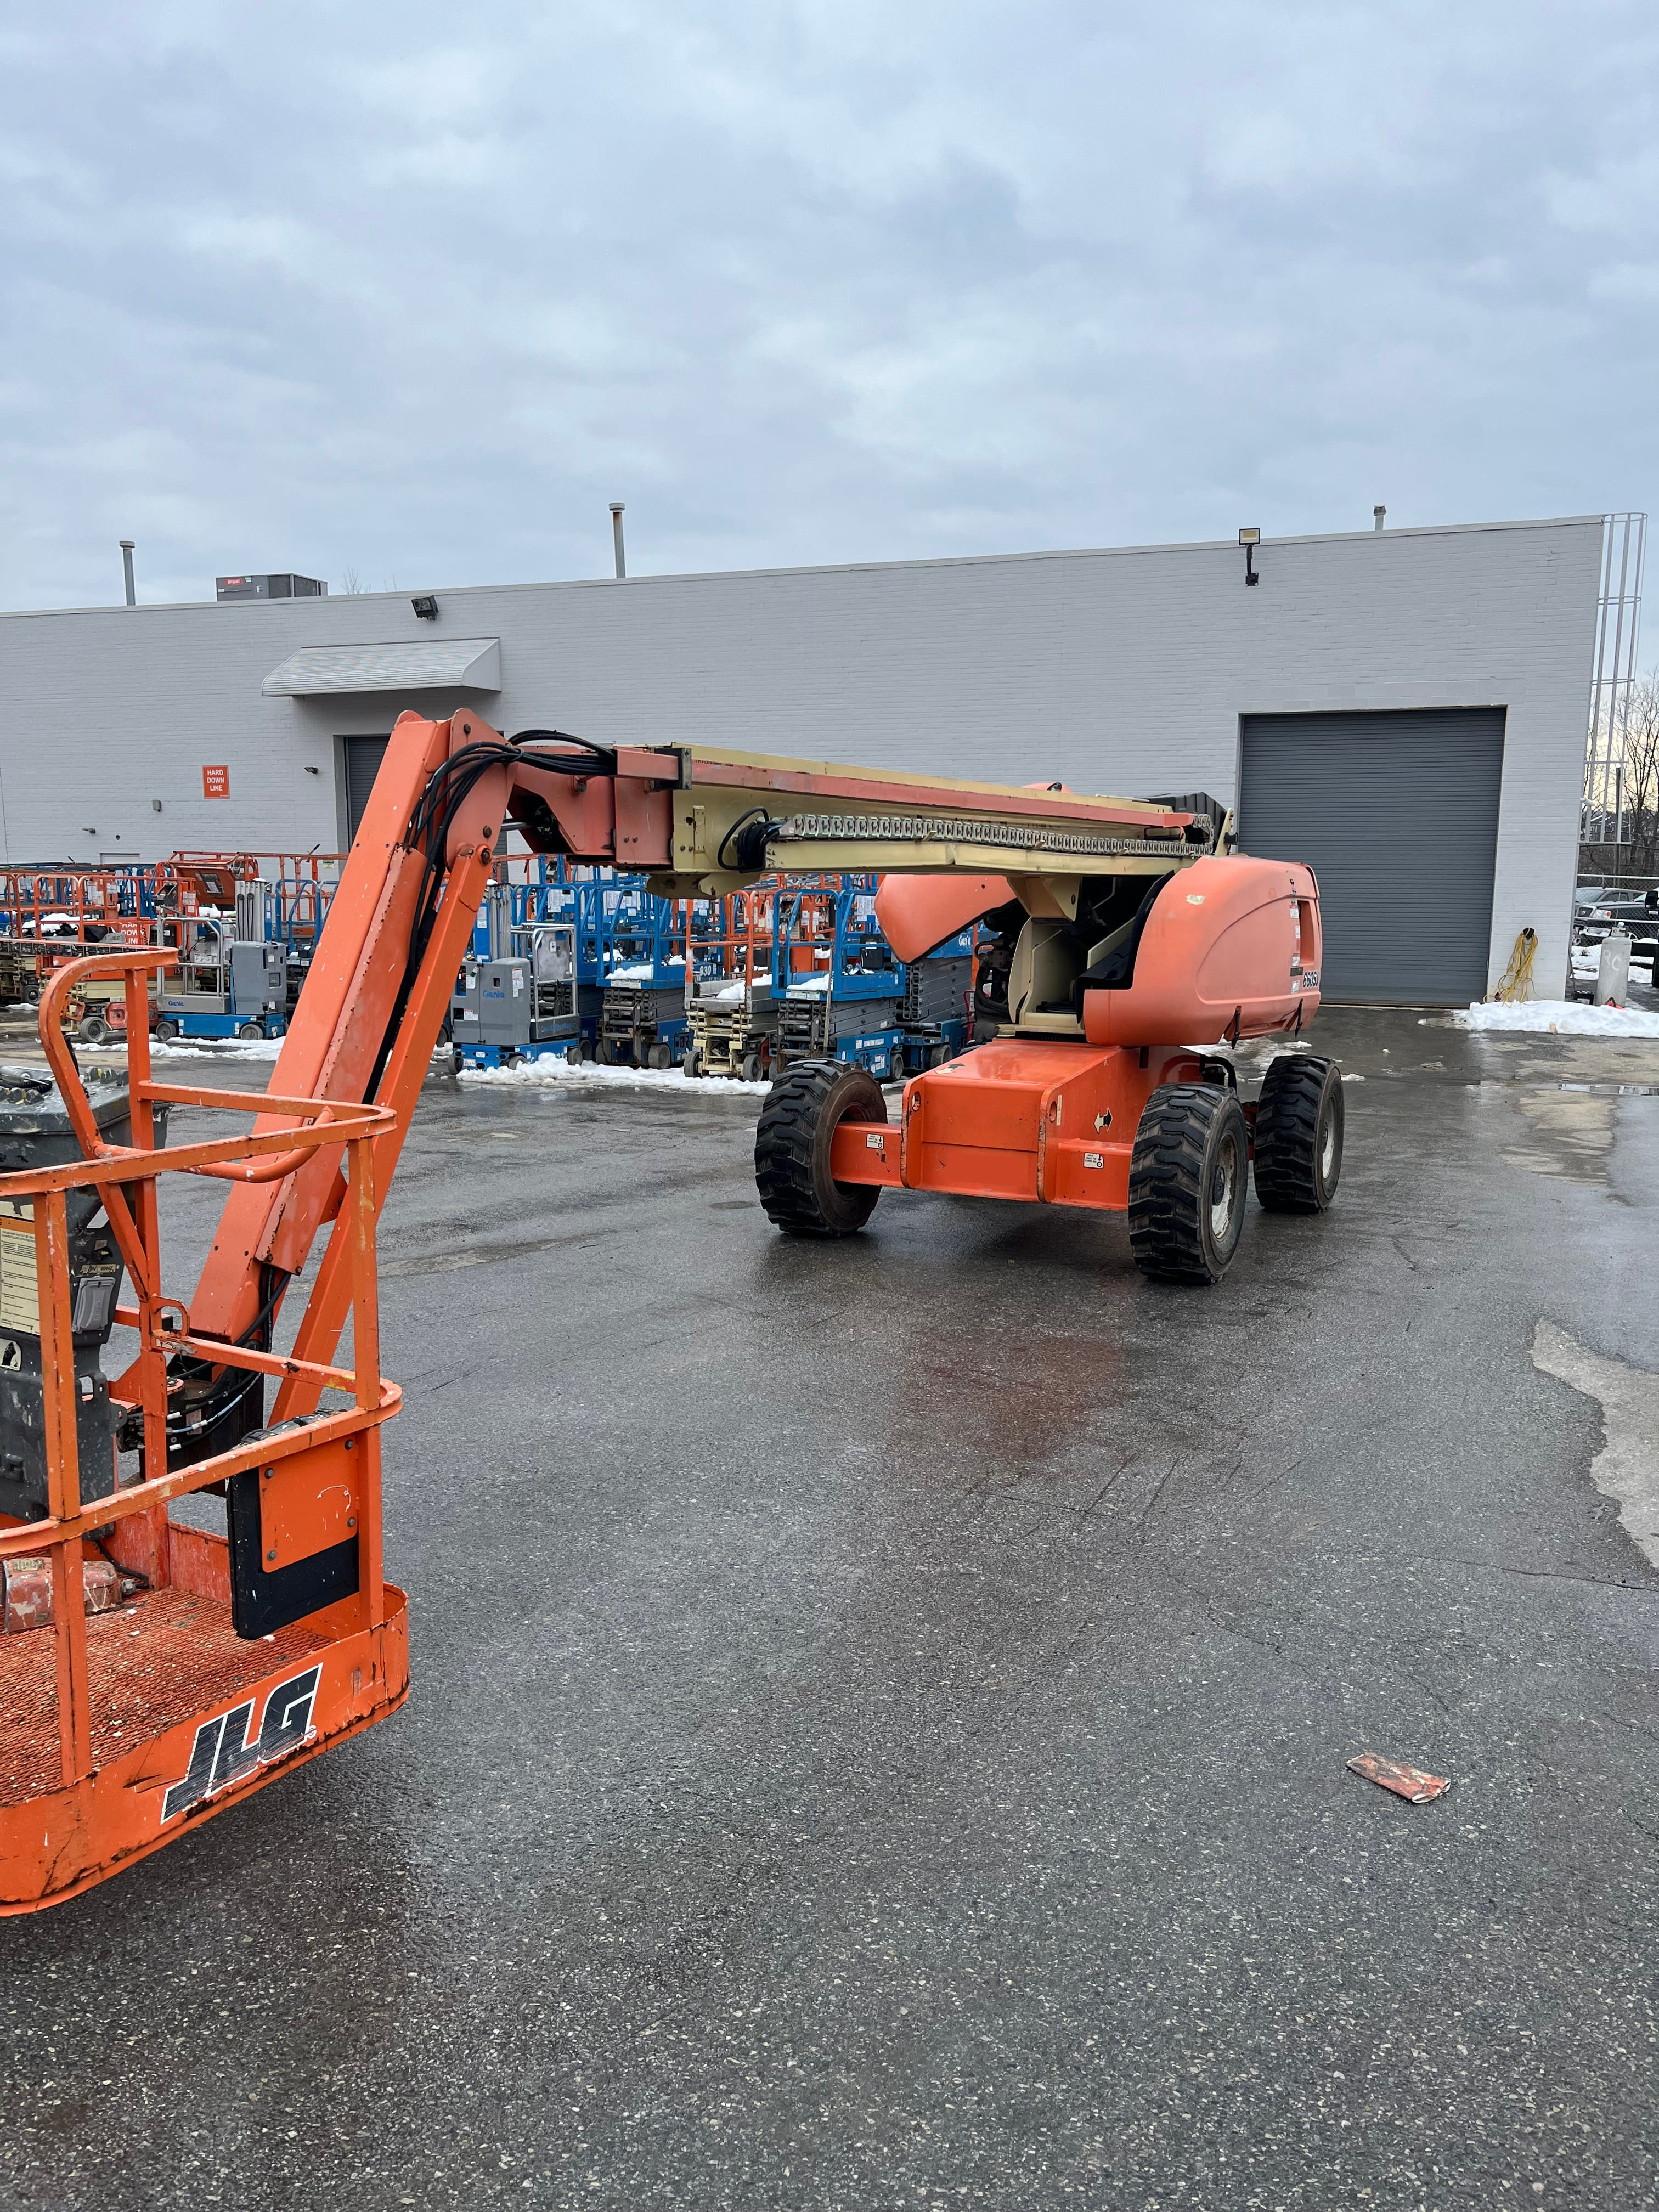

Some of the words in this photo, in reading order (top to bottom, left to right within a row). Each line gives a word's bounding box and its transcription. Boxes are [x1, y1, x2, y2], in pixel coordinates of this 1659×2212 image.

[958, 935, 971, 946] Genie
[483, 990, 505, 998] Genie
[161, 1663, 323, 1824] JLG
